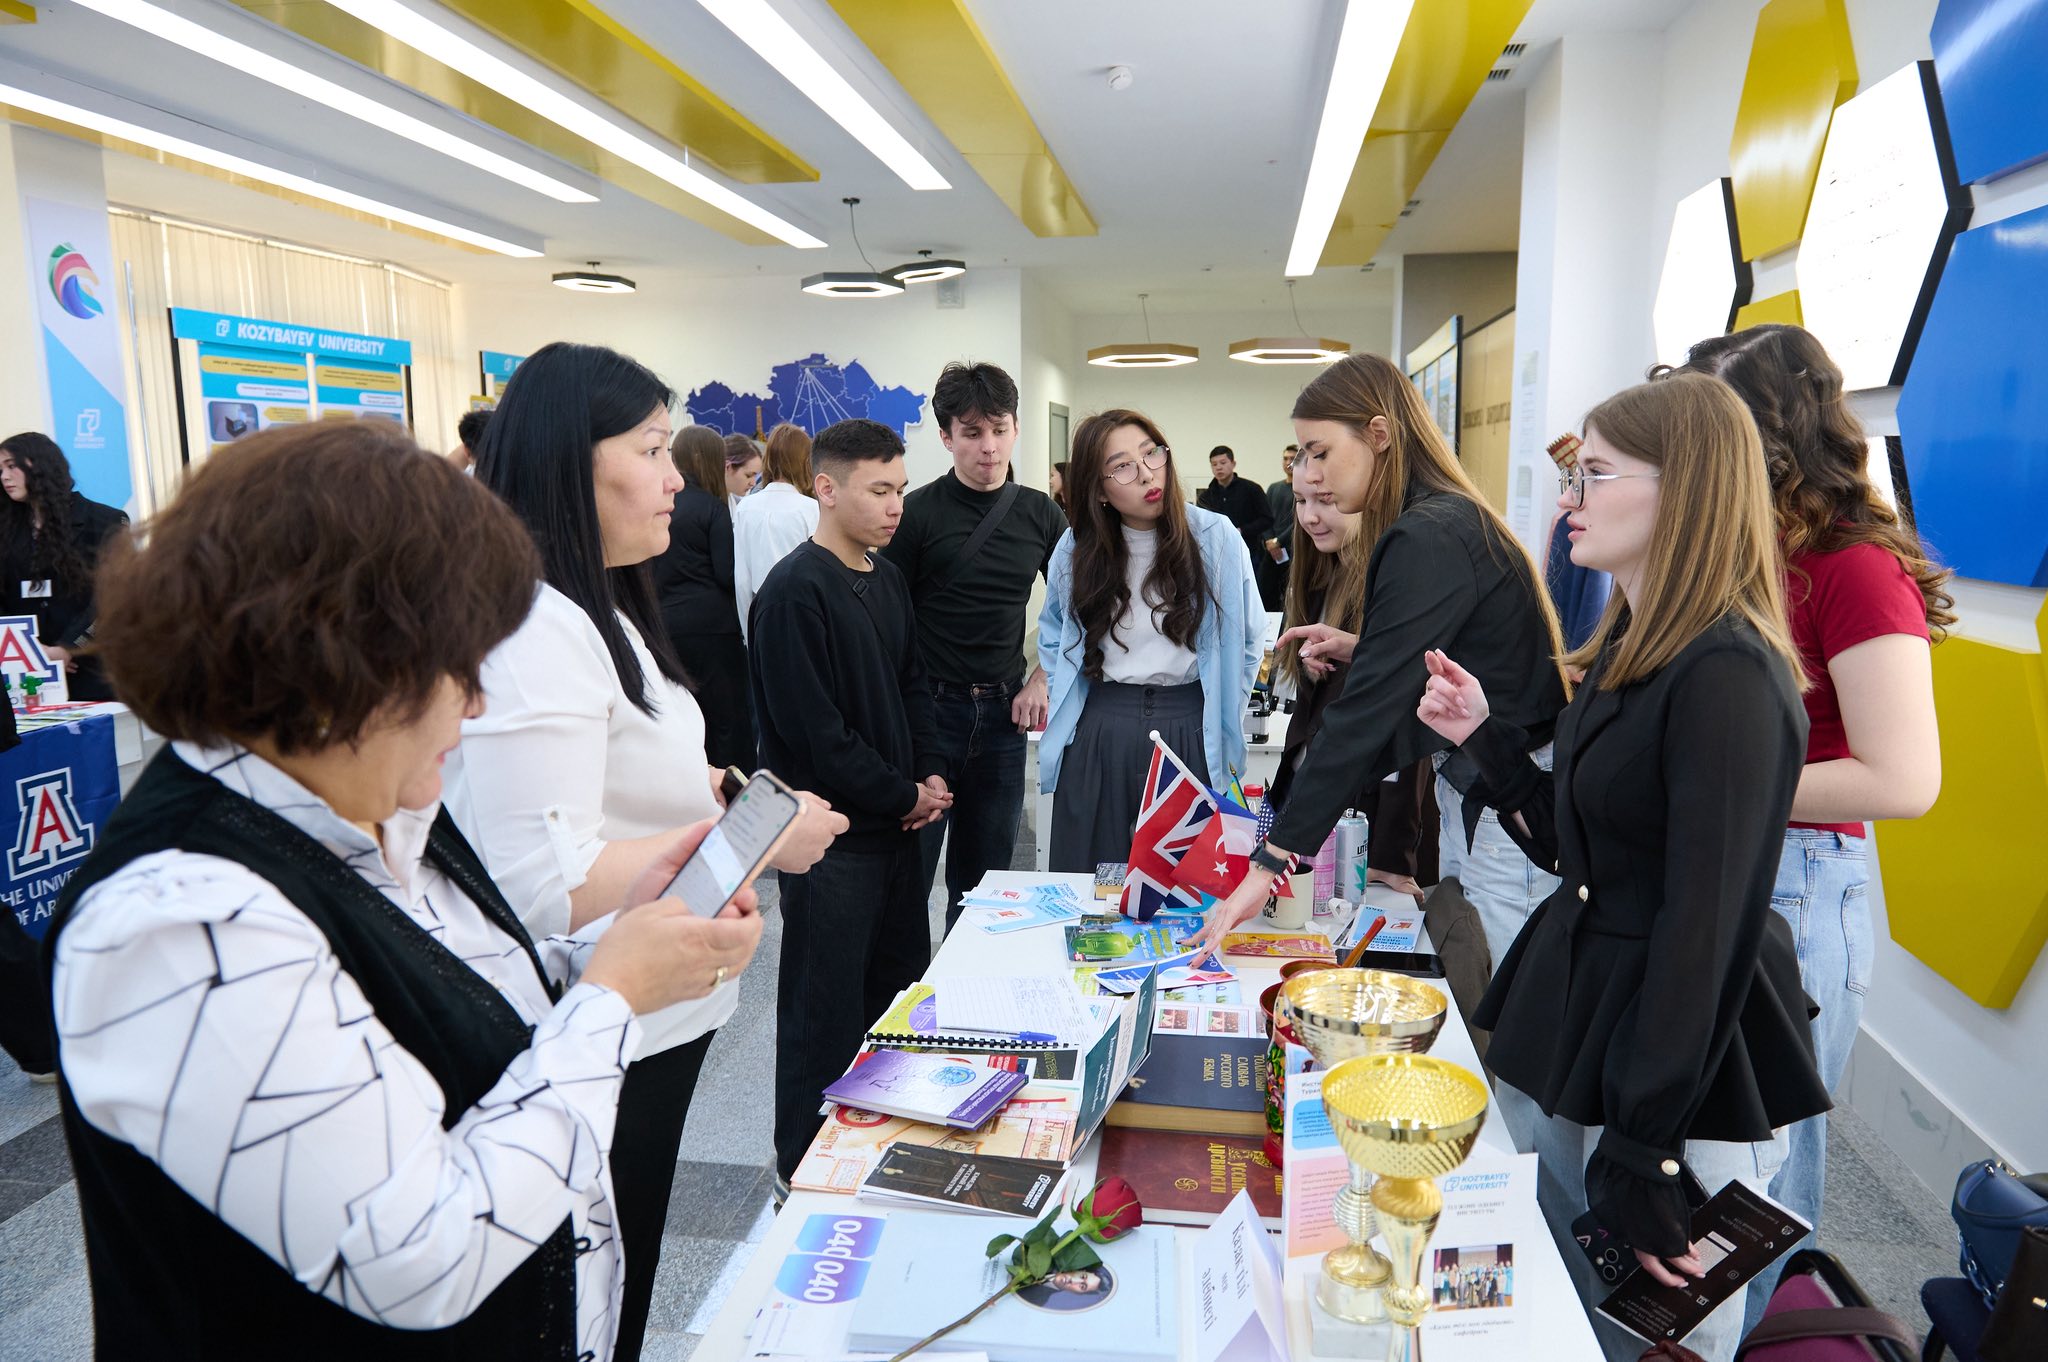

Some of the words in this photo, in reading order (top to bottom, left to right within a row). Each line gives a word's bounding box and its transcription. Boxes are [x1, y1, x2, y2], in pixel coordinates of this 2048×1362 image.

[238, 322, 314, 347] KOZYBAYEV
[318, 334, 386, 356] UNIVERSITY
[8, 768, 94, 881] A
[0, 888, 26, 906] HE
[1203, 1057, 1215, 1082] ЯЗЫКА
[1220, 1053, 1232, 1088] РУССКОГО
[1237, 1056, 1249, 1087] СЛОВАРЬ
[1459, 1181, 1509, 1191] UNIVERSITY
[1461, 1172, 1511, 1183] KOZYBAYEV
[803, 1260, 845, 1303] 040
